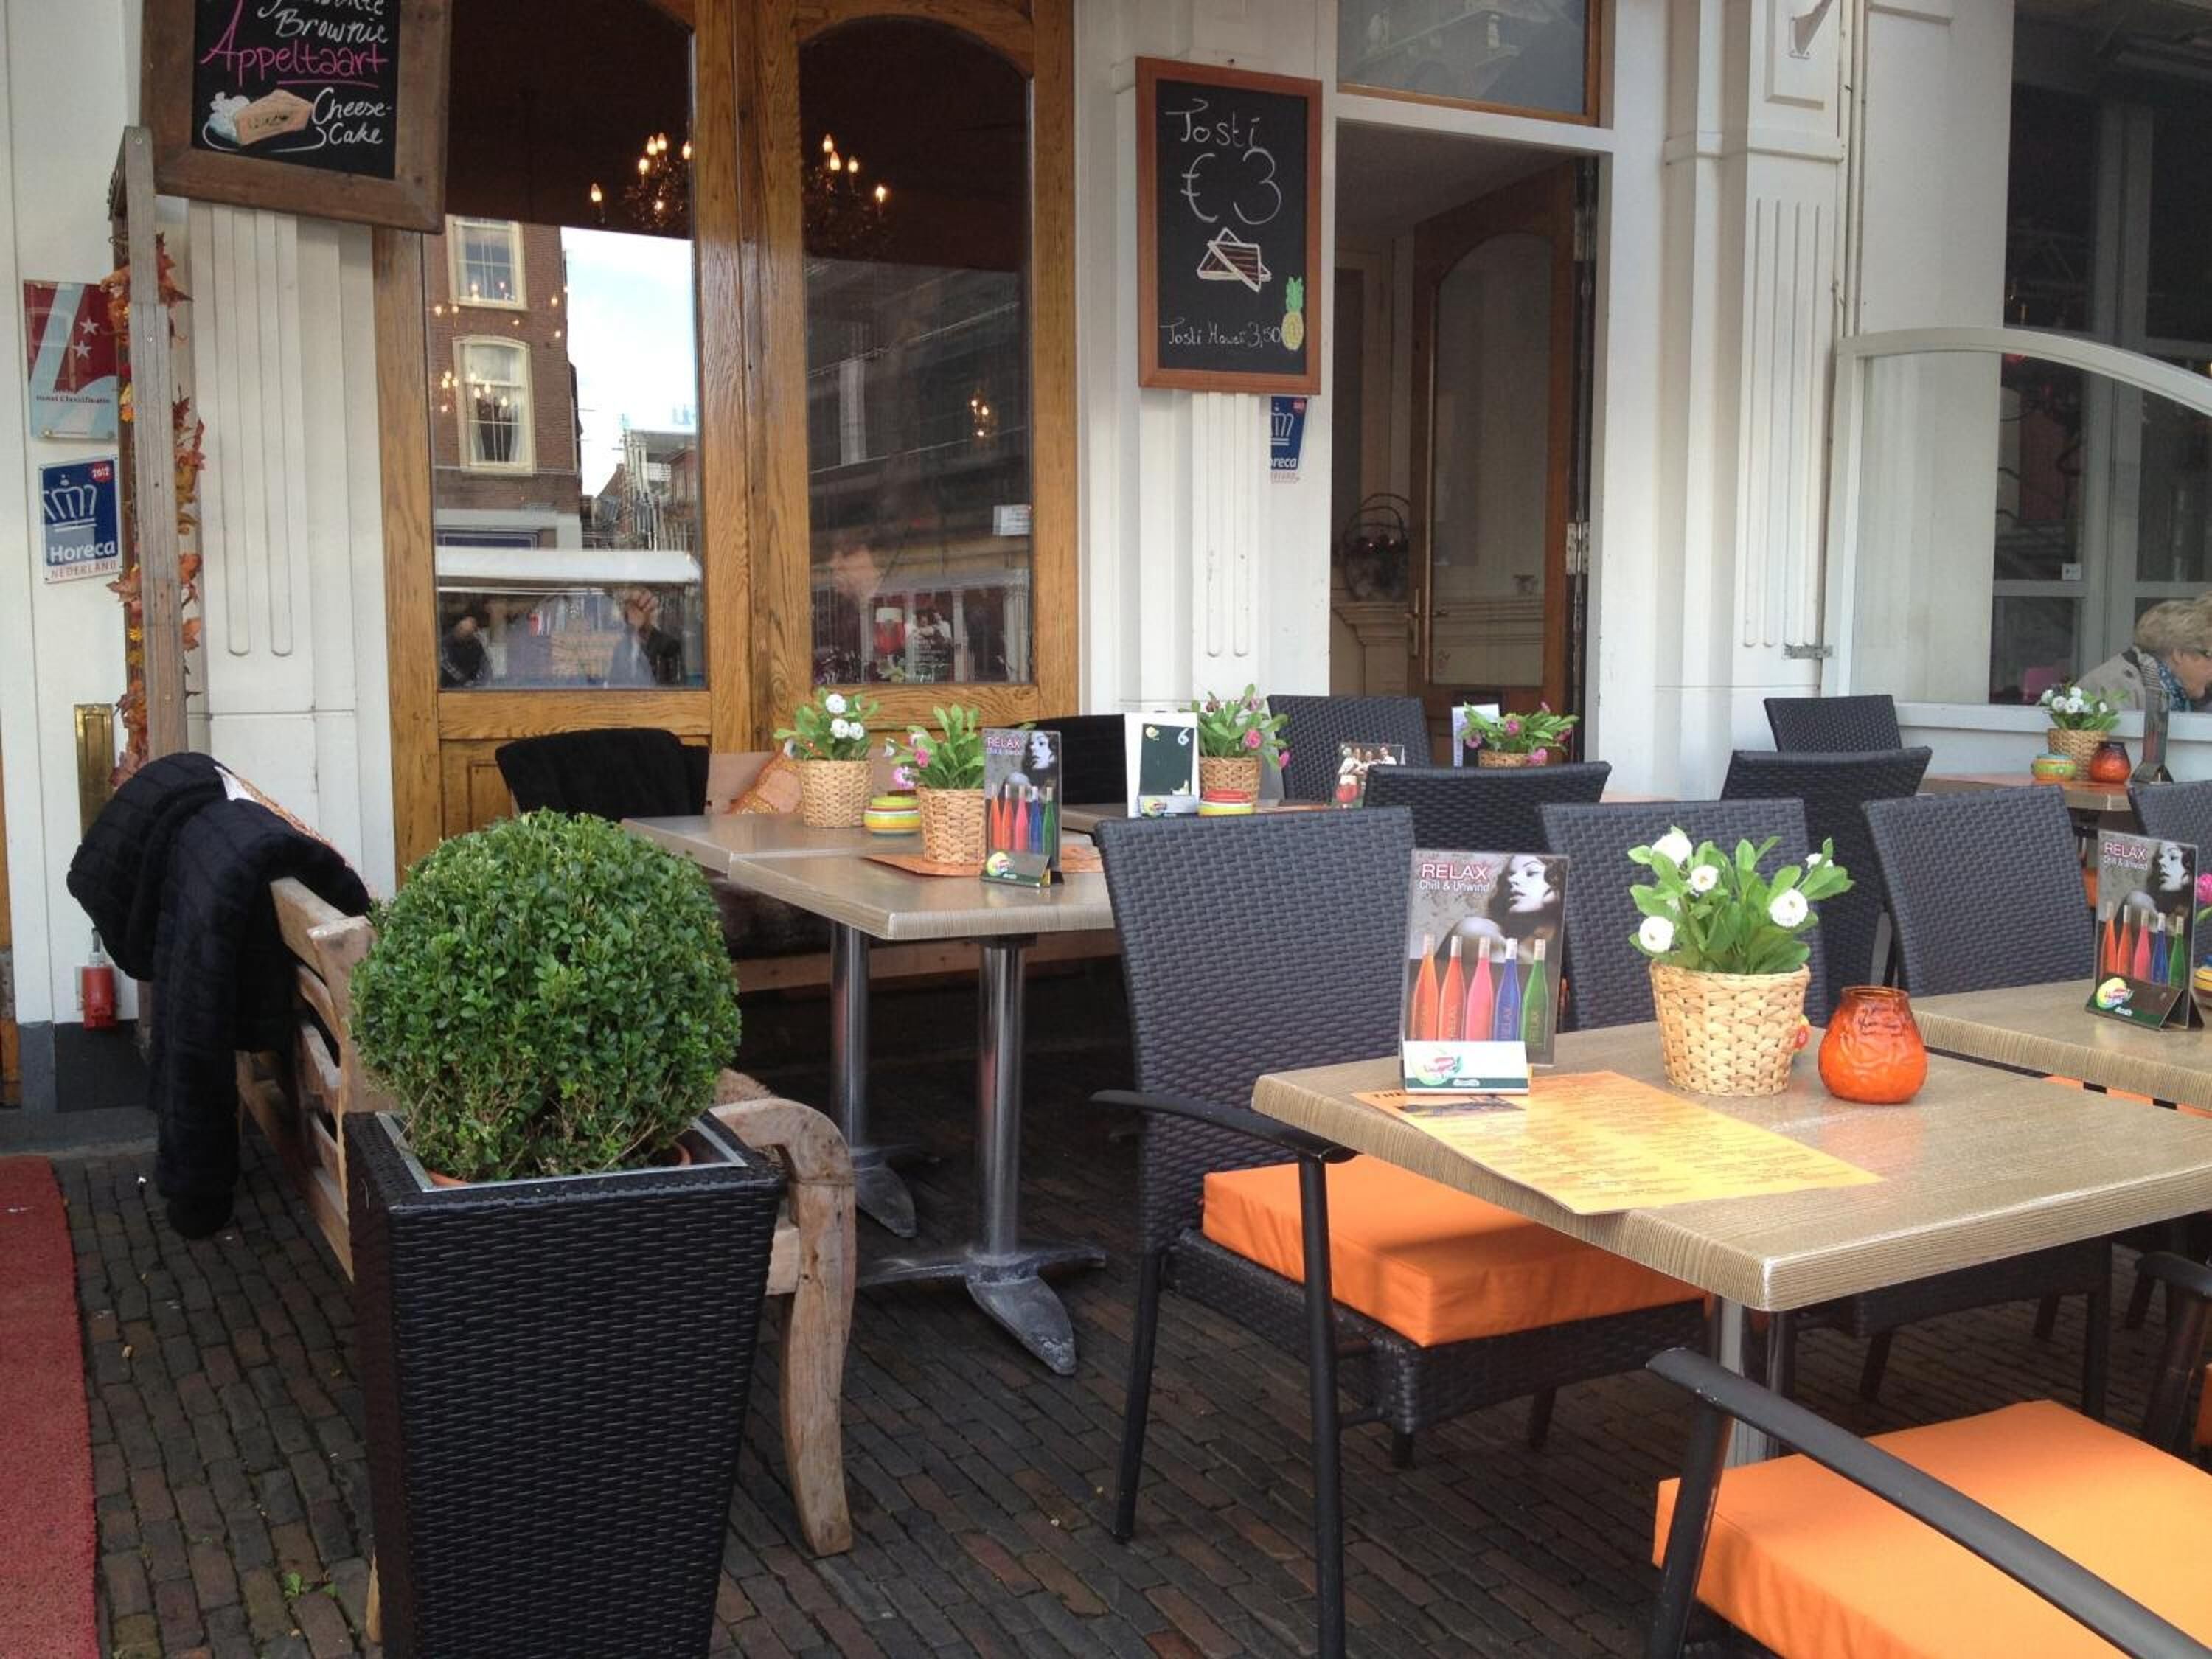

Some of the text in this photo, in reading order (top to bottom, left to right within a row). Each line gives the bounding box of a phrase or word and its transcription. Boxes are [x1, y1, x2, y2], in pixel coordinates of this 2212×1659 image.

[274, 8, 388, 43] Brownie
[199, 0, 389, 87] Appeltaart
[329, 122, 383, 145] Cake
[1166, 98, 1261, 148] Tosti
[49, 540, 116, 563] Horeca
[2104, 841, 2147, 860] RELAX
[1421, 863, 1488, 880] RELAX
